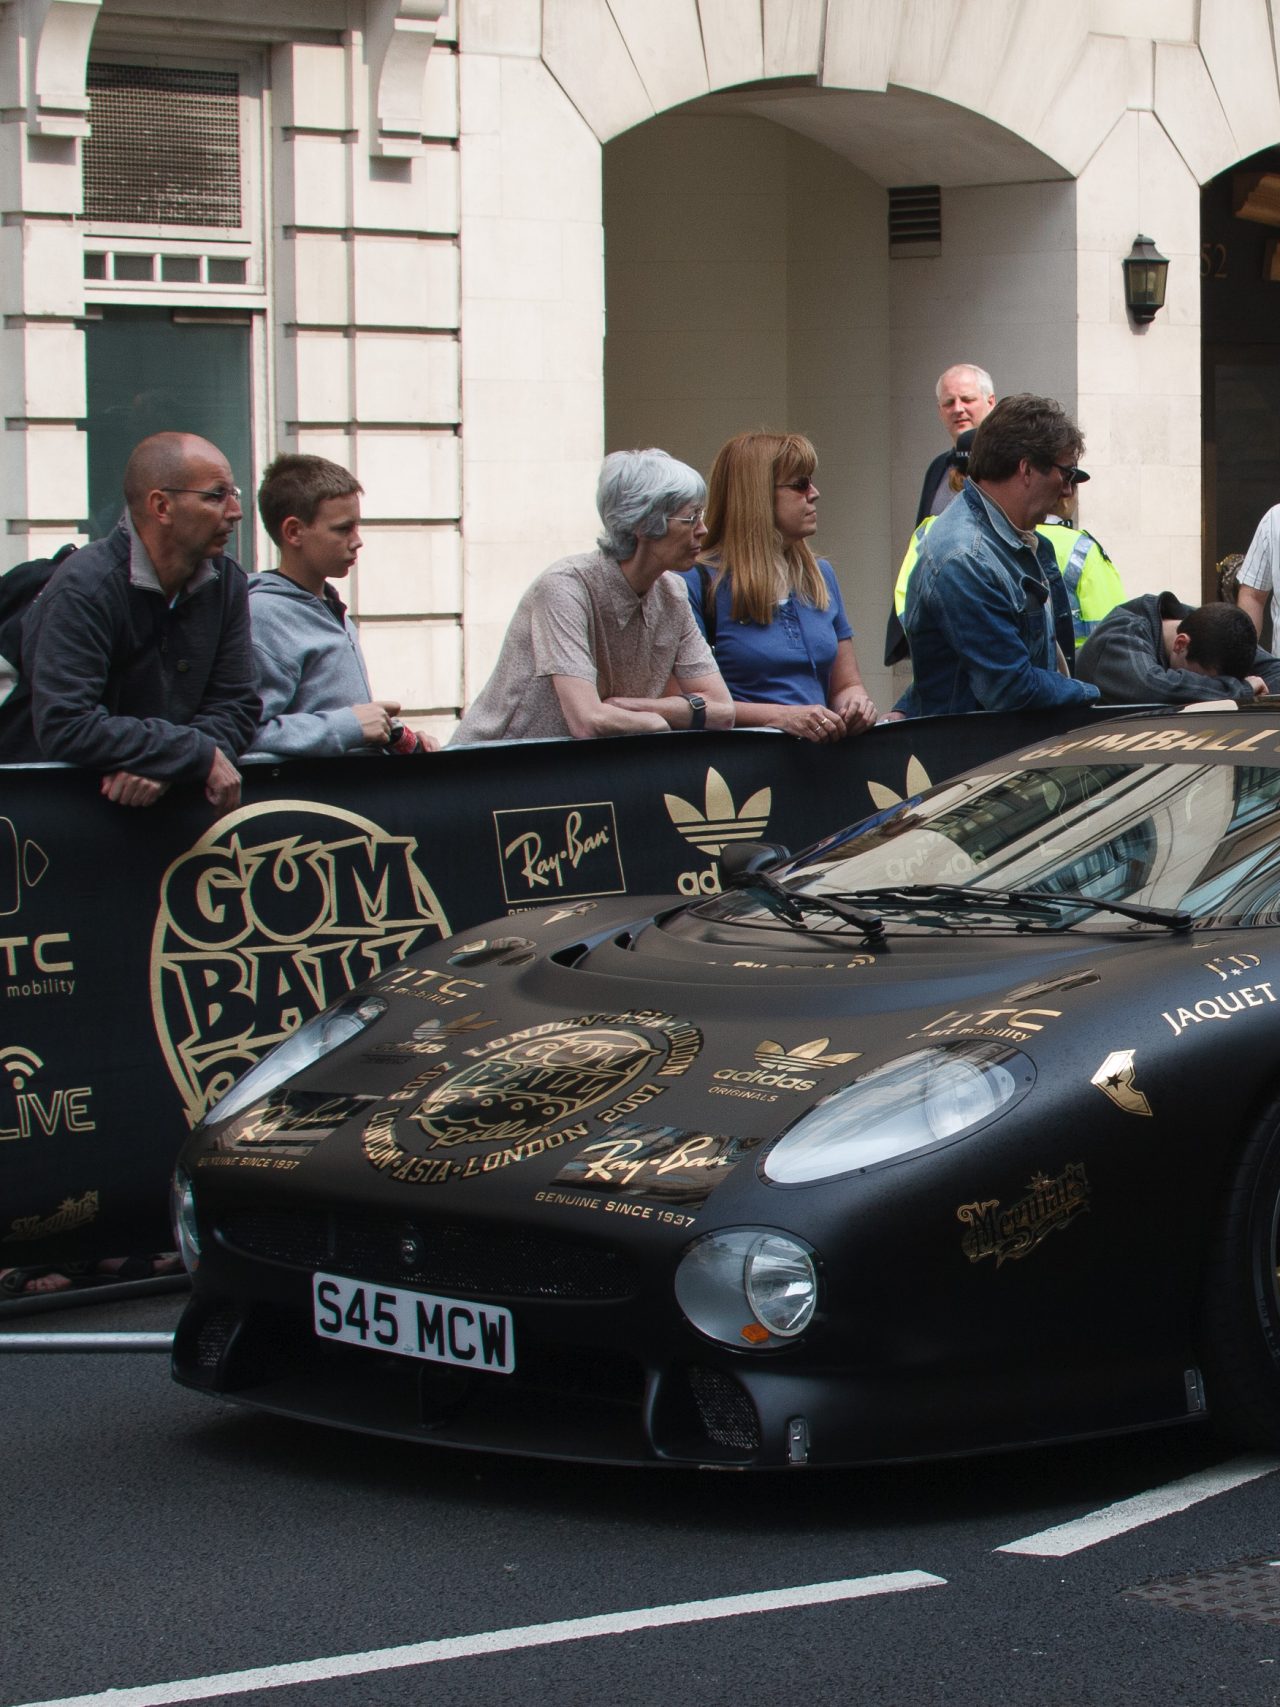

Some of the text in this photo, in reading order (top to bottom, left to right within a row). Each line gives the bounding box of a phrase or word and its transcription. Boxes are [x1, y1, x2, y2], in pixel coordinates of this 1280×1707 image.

[7, 978, 76, 998] mobility
[1162, 982, 1276, 1037] JAQUET
[463, 1013, 600, 1058] LONDON
[656, 1021, 702, 1077] LONDON
[957, 1028, 1033, 1042] mobility
[387, 1061, 457, 1101] 2007
[708, 1086, 779, 1103] ORIGINALS
[713, 1069, 817, 1091] adidas
[597, 1084, 666, 1123] 2007
[362, 1108, 589, 1183] LONDON ASIA LONDON
[428, 1118, 543, 1150] Rally
[239, 1157, 272, 1169] SINCE
[273, 1159, 300, 1171] 1937
[534, 1191, 696, 1229] GENUINE SINCE 1937
[317, 1280, 507, 1368] S45 MCW
